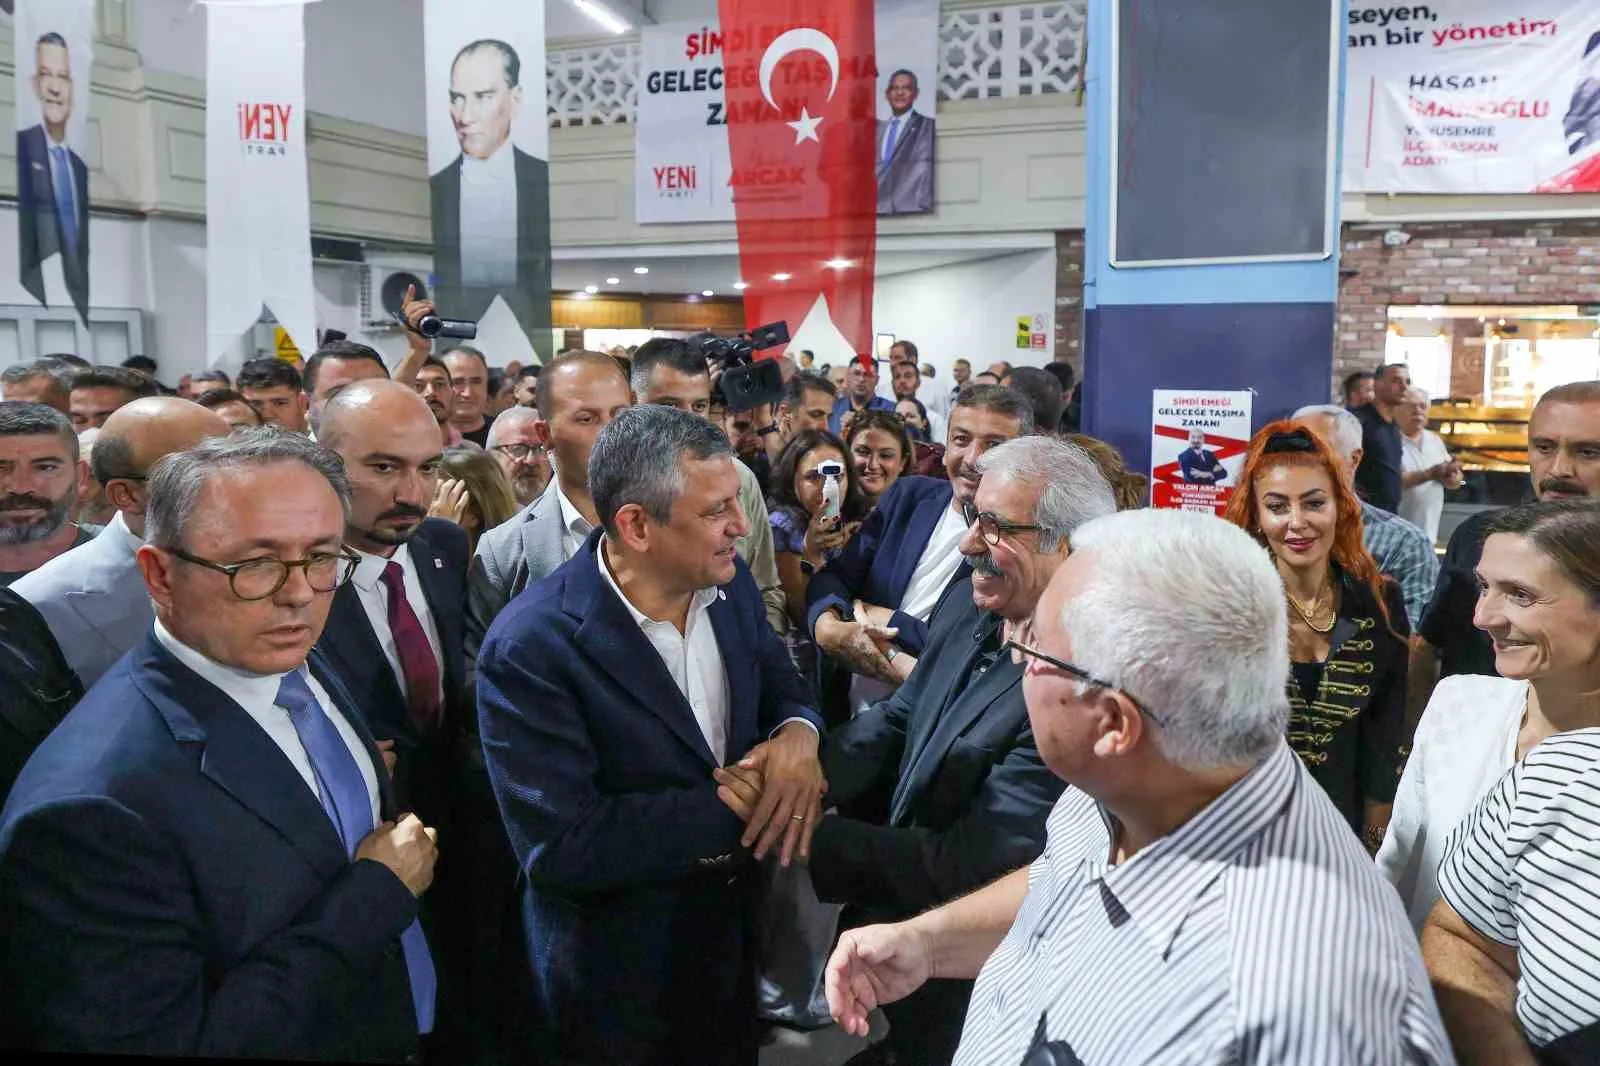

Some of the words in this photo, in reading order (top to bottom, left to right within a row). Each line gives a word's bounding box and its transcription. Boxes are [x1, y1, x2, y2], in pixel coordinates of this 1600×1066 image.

[1348, 4, 1438, 27] seyen,
[1386, 26, 1425, 46] bir
[646, 57, 761, 95] GELECEĞ
[780, 53, 879, 88] TAŞMA
[653, 164, 697, 189] YENİ
[1181, 418, 1221, 427] ZAMANI
